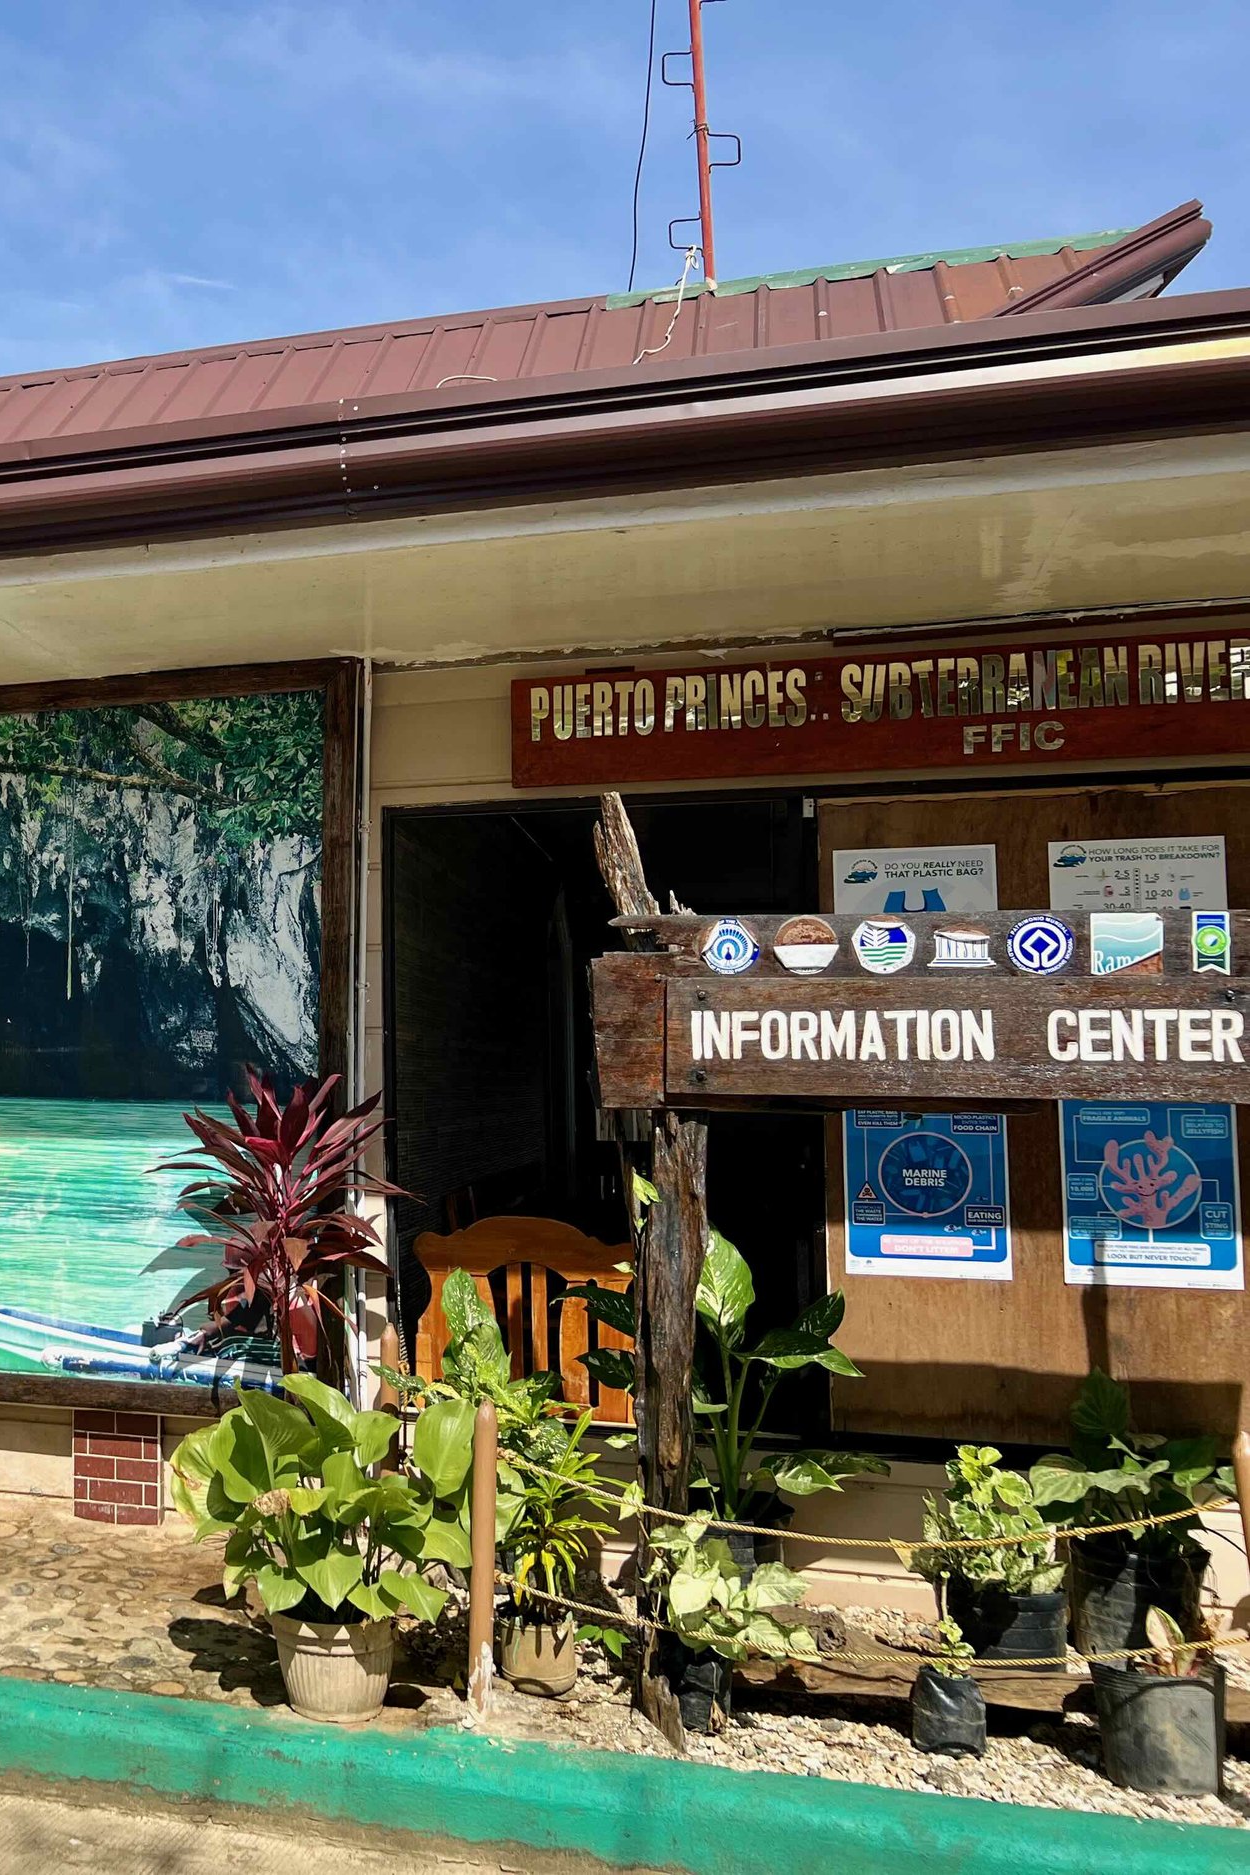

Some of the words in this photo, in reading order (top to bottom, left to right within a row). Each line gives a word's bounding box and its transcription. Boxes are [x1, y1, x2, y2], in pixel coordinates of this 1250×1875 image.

[530, 678, 655, 742] PUERTO
[840, 646, 1130, 723] SUBTERRANEAN
[1138, 638, 1250, 705] RIVER
[962, 720, 1066, 755] FFIC
[1158, 852, 1221, 860] BREAKDOWN?
[923, 860, 957, 869] REALLY
[884, 870, 911, 878] THAT
[913, 869, 953, 877] PLASTIC
[956, 868, 984, 876] BAG?
[1145, 889, 1173, 897] 10-20
[690, 1009, 996, 1062] INFORMATION
[1047, 1008, 1246, 1063] CENTER
[902, 1168, 947, 1178] MARINE
[905, 1178, 945, 1187] DEBRIS
[967, 1211, 1002, 1219] EATING
[1205, 1210, 1228, 1219] CUT
